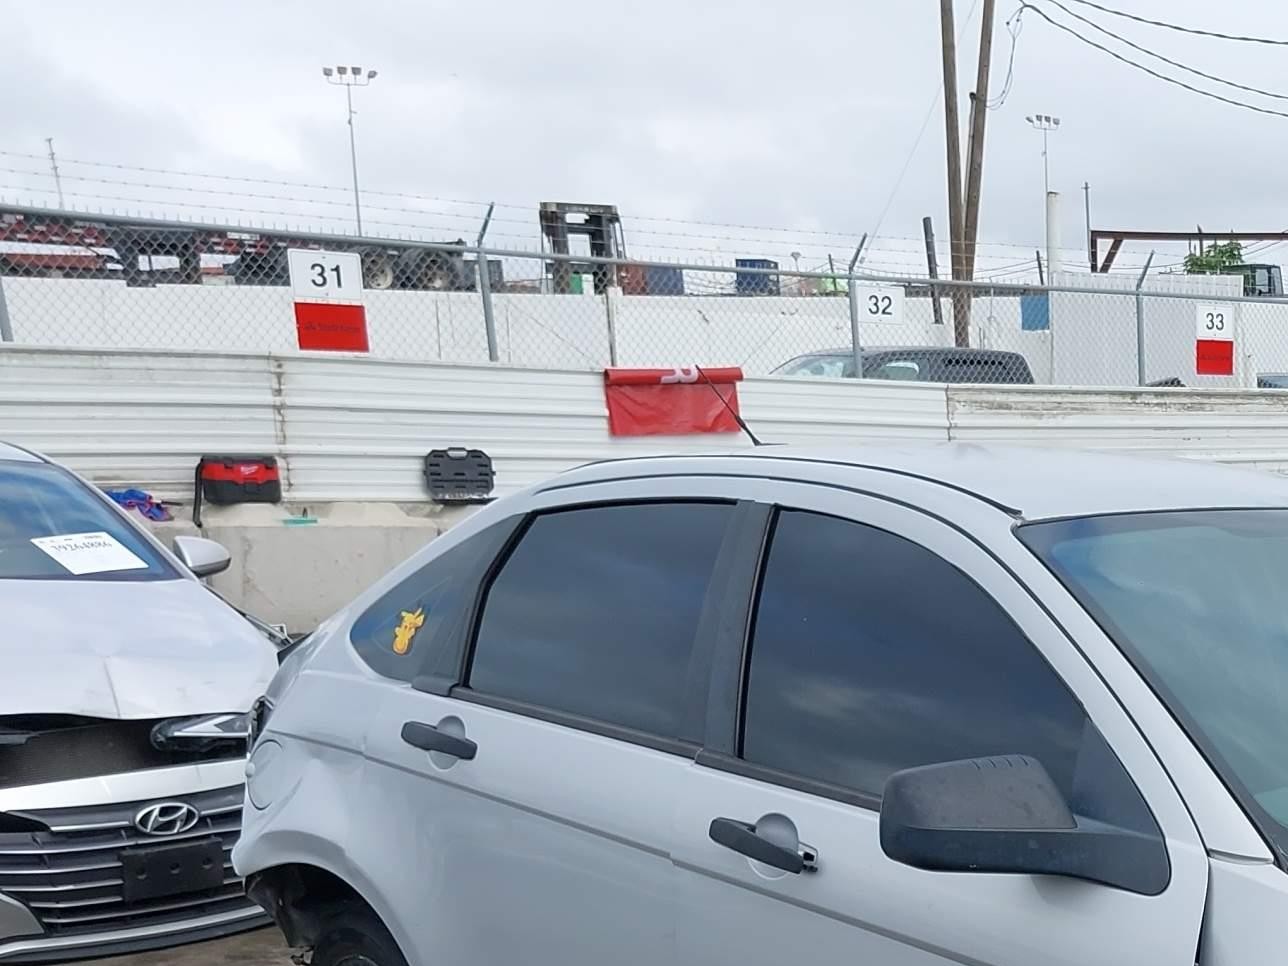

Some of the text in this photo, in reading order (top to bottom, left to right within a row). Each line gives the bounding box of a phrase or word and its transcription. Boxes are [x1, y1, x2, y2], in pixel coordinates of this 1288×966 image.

[310, 263, 342, 288] 31
[868, 294, 893, 315] 32
[1206, 312, 1224, 331] 33
